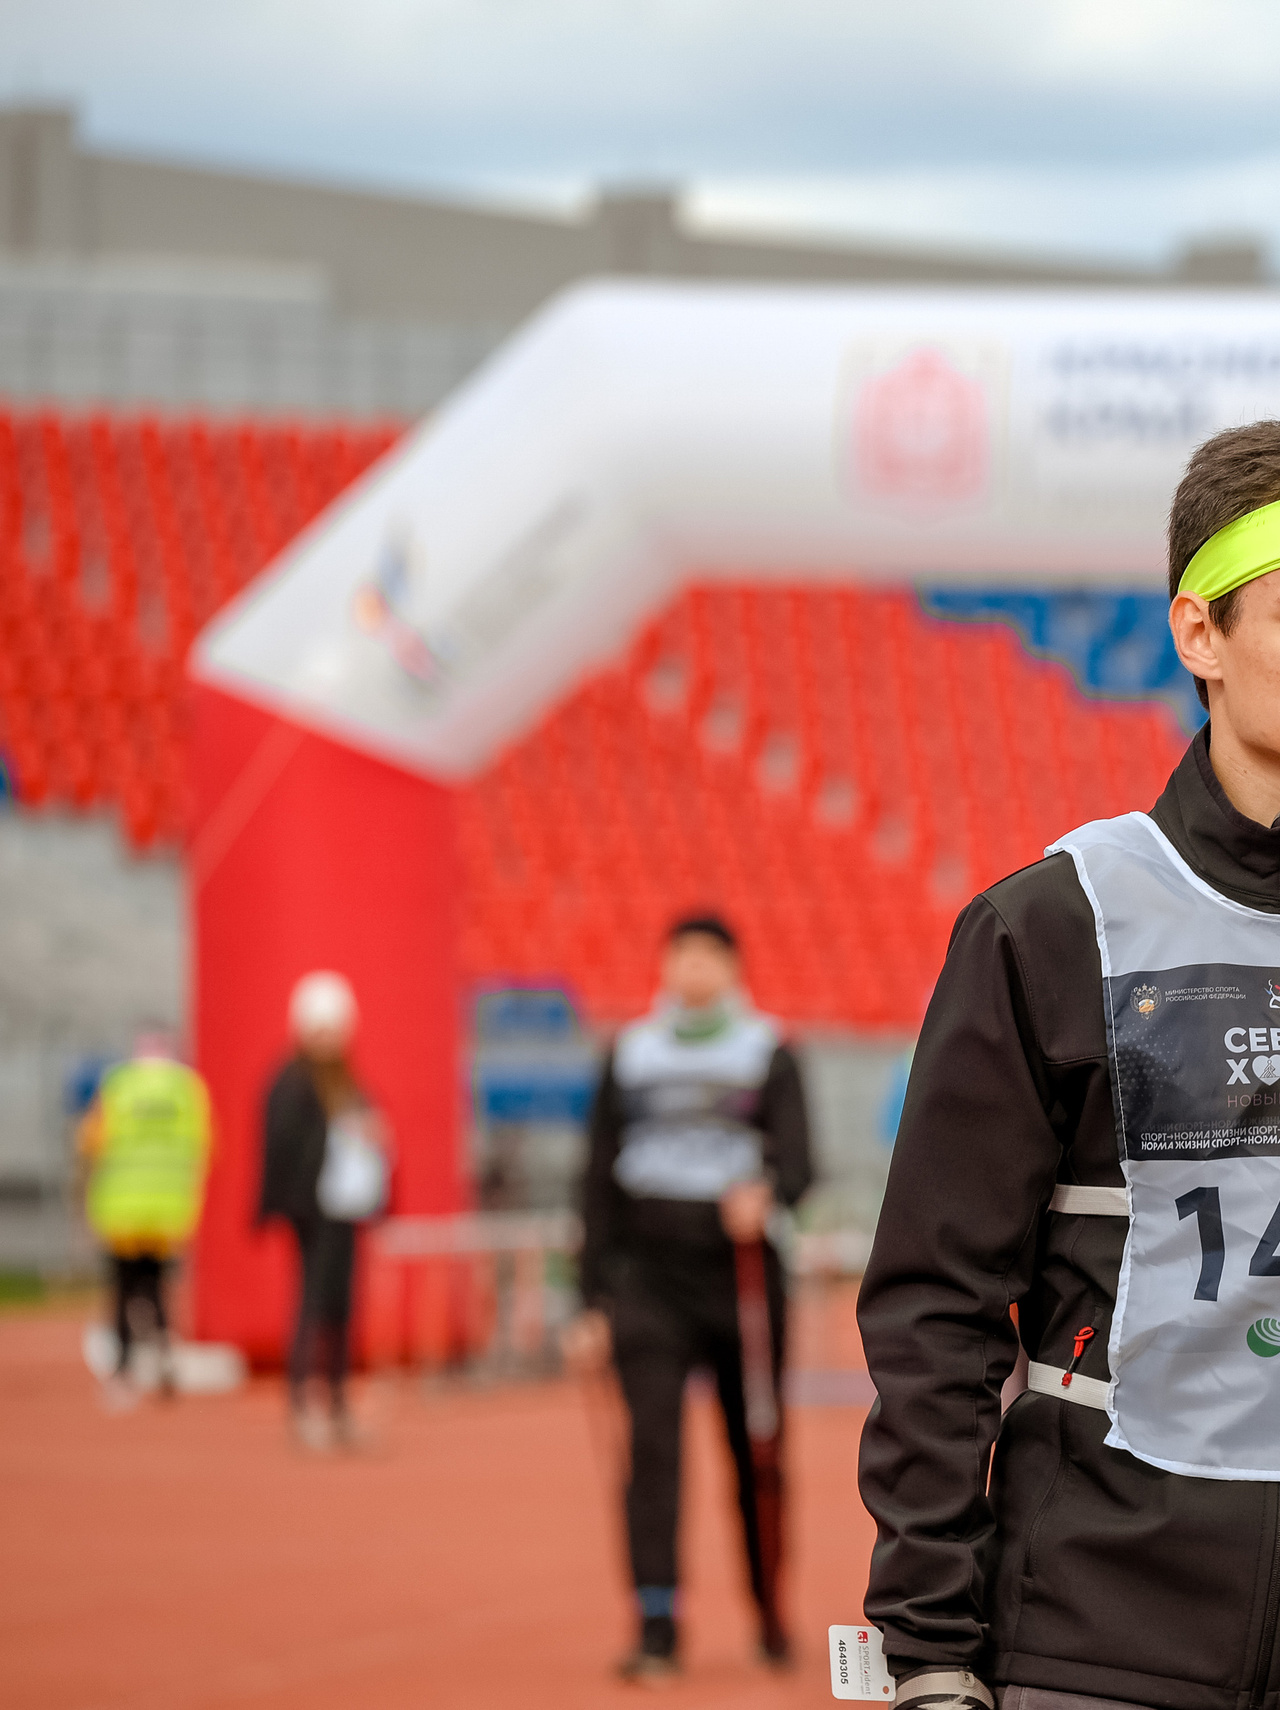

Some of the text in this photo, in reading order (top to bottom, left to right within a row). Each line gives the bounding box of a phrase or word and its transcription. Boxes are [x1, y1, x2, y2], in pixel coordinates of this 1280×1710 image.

[1165, 986, 1240, 997] МИНИСТЕРСТВО СПОРТА
[1165, 993, 1247, 1003] РОССИЙСКОЙ ФЕДЕРАЦИИ
[1211, 1126, 1247, 1138] ЖИЗНИ
[1141, 1140, 1174, 1151] НОРМА
[1174, 1139, 1210, 1150] ЖИЗНИ
[838, 1639, 849, 1685] 4649305
[964, 1673, 971, 1682] R
